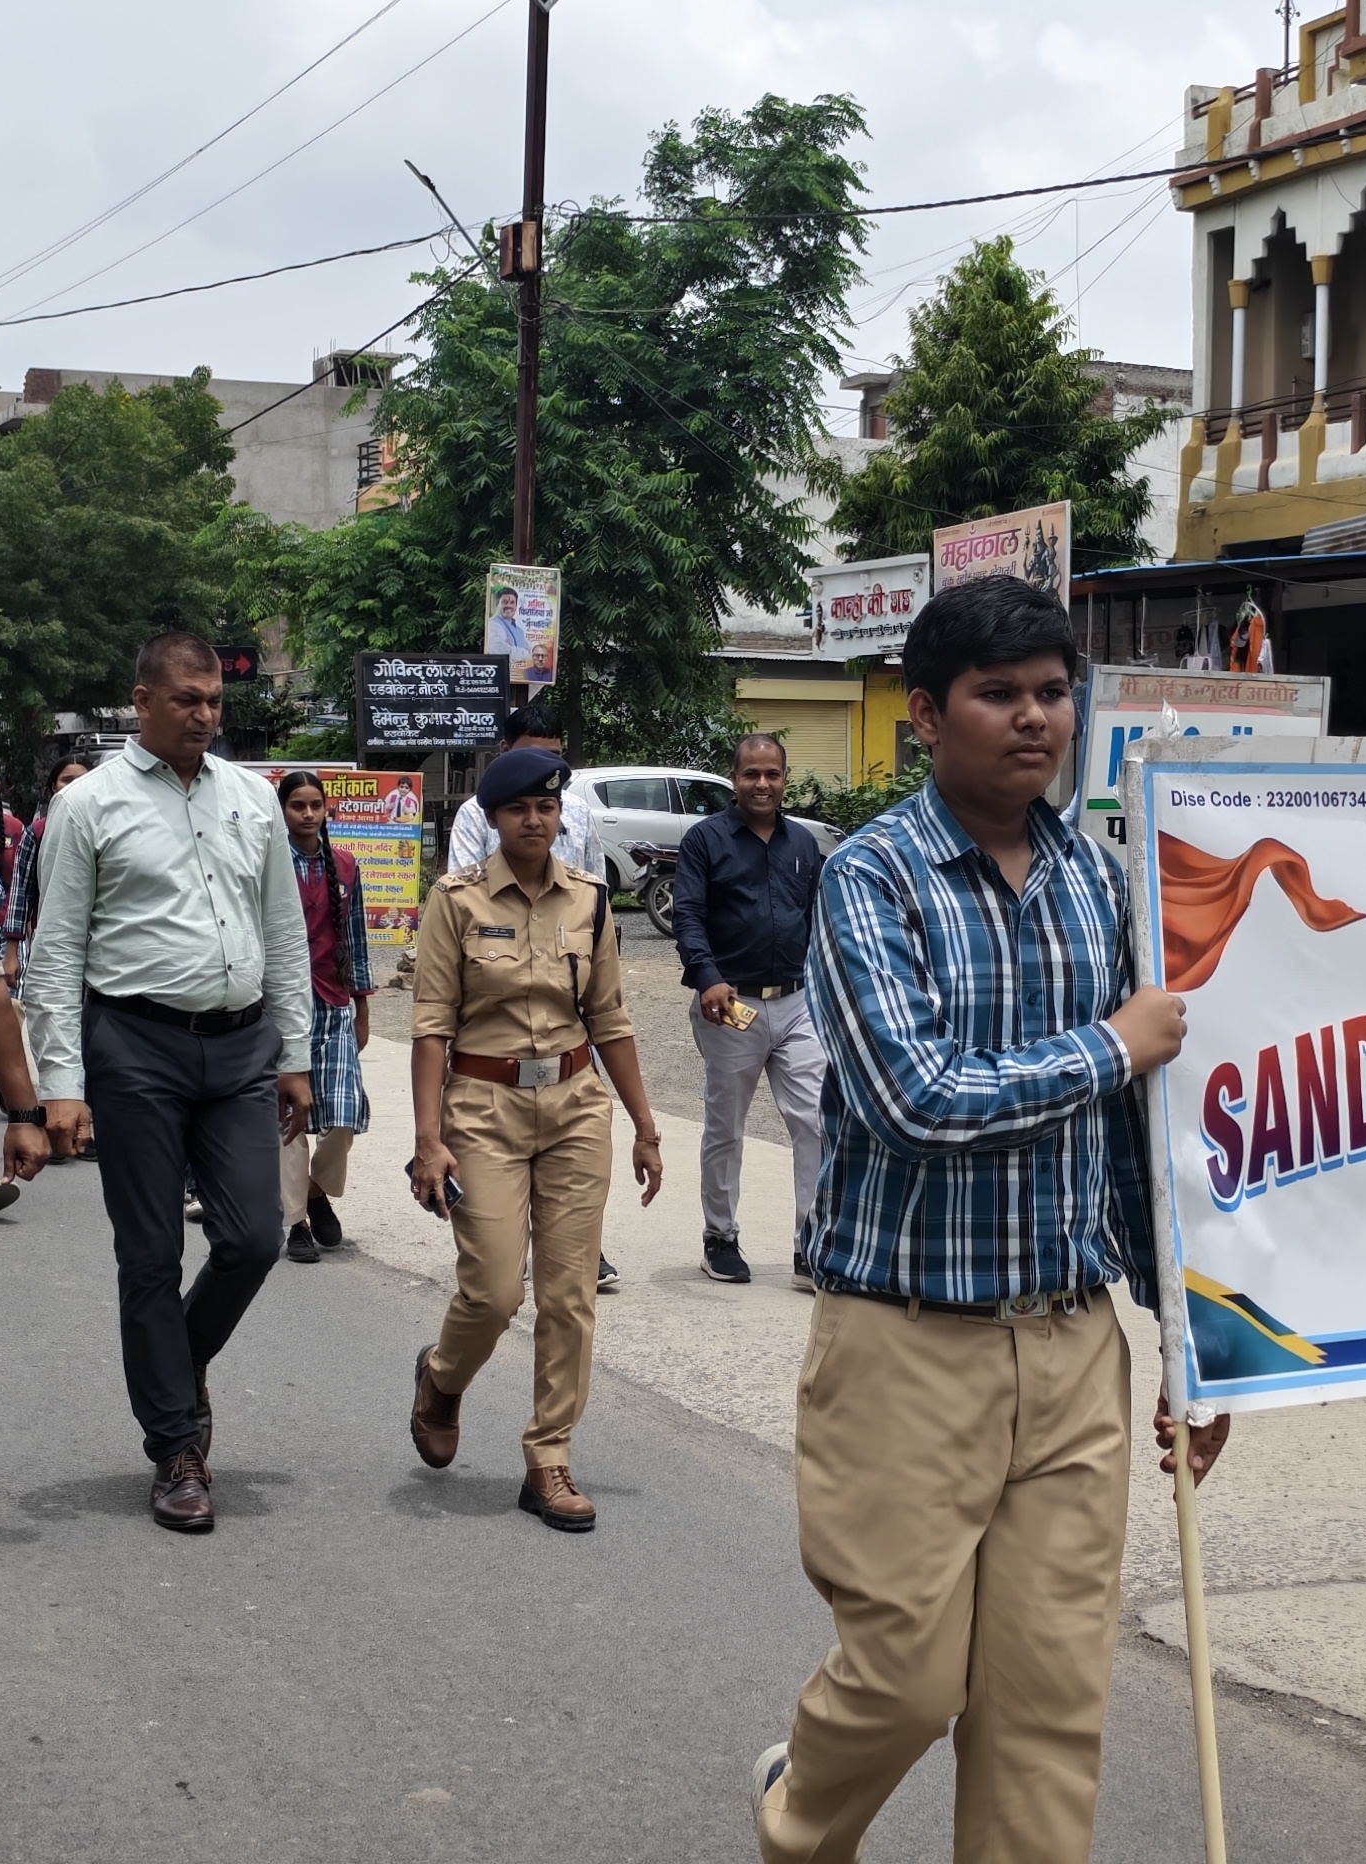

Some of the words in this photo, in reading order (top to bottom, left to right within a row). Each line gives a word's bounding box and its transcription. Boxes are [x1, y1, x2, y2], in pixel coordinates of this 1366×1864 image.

[868, 583, 885, 615] की
[413, 711, 452, 729] कुमार
[453, 707, 495, 725] गोयल
[338, 798, 385, 814] स्टेशनरी
[1171, 790, 1206, 807] Dise
[1210, 791, 1252, 807] Code
[1257, 795, 1262, 807] :
[1267, 791, 1366, 807] 23200106734
